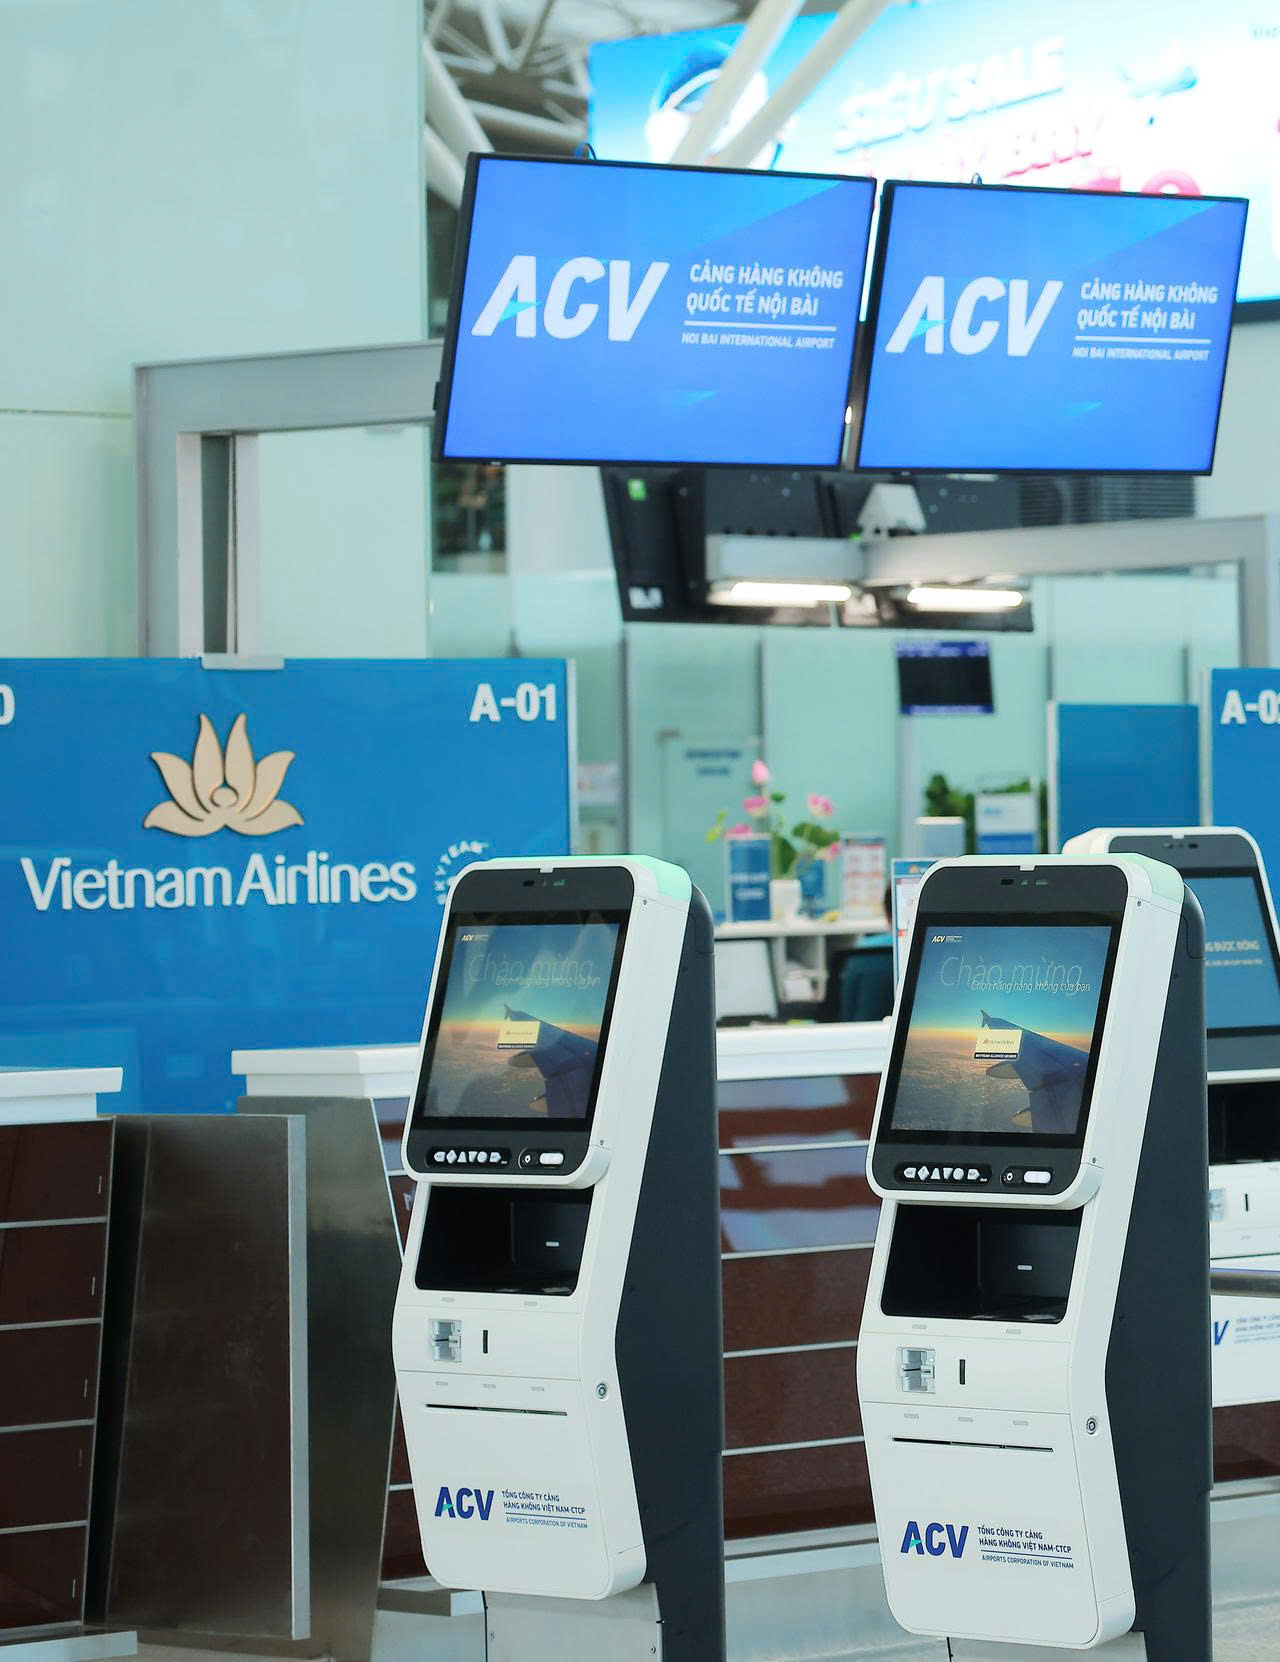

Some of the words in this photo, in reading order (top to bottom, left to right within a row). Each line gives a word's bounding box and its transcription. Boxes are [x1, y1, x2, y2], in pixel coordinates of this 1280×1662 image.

[690, 259, 735, 284] CẢNG
[738, 262, 784, 286] HÀNG
[787, 265, 844, 289] KHÔNG
[471, 255, 670, 342] ACV
[686, 286, 731, 315] QUỐC
[735, 288, 757, 314] TẾ
[758, 292, 786, 320] NỘI
[790, 293, 819, 316] BÀI
[1080, 277, 1121, 300] CẢNG
[1123, 279, 1165, 302] HÀNG
[1168, 281, 1218, 304] KHÔNG
[885, 275, 1064, 357] ACV
[1077, 304, 1119, 331] QUỐC
[1121, 304, 1141, 329] TẾ
[1141, 307, 1167, 334] NỘI
[1170, 307, 1196, 330] BÀI
[681, 332, 699, 345] NOI
[701, 333, 718, 345] BAI
[719, 333, 793, 348] INTERNATIONAL
[795, 336, 835, 349] AIRPORT
[1106, 347, 1172, 360] INTERNATIONAL
[1174, 349, 1209, 361] AIRPORT
[469, 683, 557, 722] A-01
[21, 857, 231, 911] Vietnam
[236, 851, 417, 905] Airlines
[931, 935, 946, 943] ACV
[940, 955, 1002, 987] Chào
[1011, 955, 1083, 996] mừng
[434, 1486, 495, 1521] ACV
[502, 1488, 518, 1499] TỔNG
[518, 1490, 534, 1500] CÔNG
[543, 1491, 560, 1502] CẢNG
[503, 1500, 520, 1510] HÀNG
[521, 1501, 542, 1511] KHÔNG
[542, 1503, 555, 1513] VIỆT
[528, 1518, 559, 1527] CORPORATION
[567, 1521, 588, 1529] VIETNAM
[977, 1523, 995, 1536] TỔNG
[996, 1526, 1014, 1537] CÔNG
[1015, 1529, 1024, 1538] TY
[1024, 1528, 1043, 1540] CẢNG
[900, 1520, 970, 1559] ACV
[979, 1536, 998, 1547] HÀNG
[998, 1538, 1022, 1549] KHÔNG
[1022, 1540, 1037, 1552] VIỆT
[981, 1554, 1007, 1563] AIRPORTS
[1007, 1556, 1042, 1566] CORPORATION
[1050, 1560, 1074, 1569] VIETNAM
